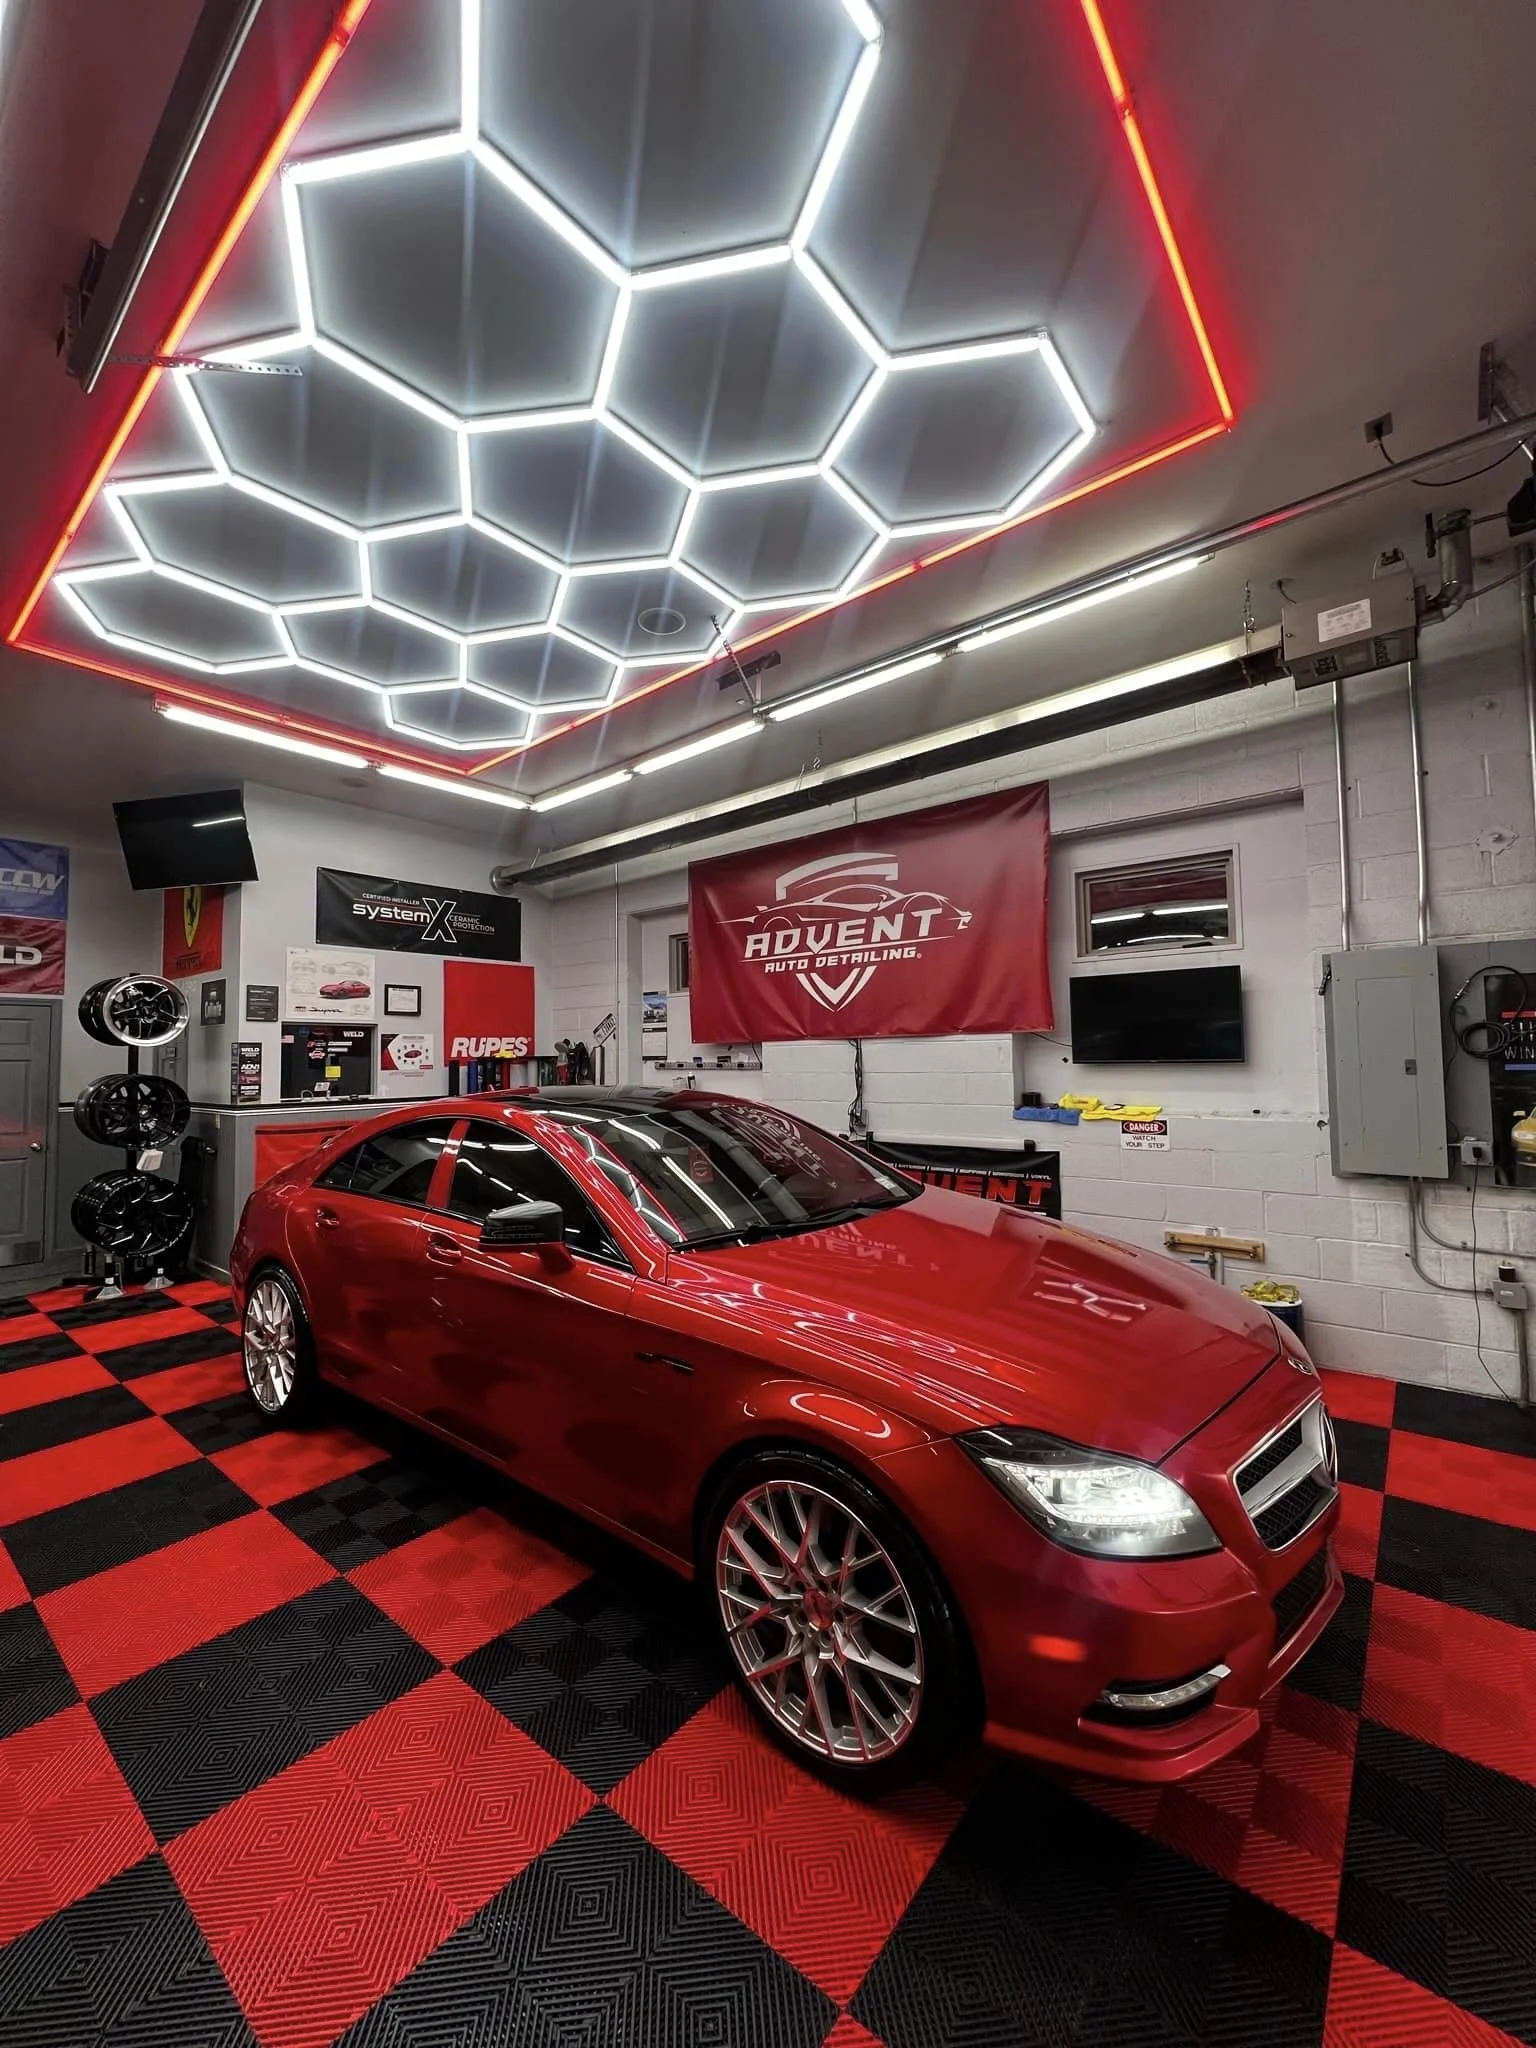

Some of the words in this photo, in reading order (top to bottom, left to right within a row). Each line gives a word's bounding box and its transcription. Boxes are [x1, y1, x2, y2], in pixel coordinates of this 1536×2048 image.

[362, 893, 391, 902] CERTIFIED
[391, 897, 420, 905] INSTALLER
[449, 915, 480, 925] CERAMIC
[452, 921, 495, 932] PROTECTION
[744, 907, 943, 958] ADVENT
[764, 958, 808, 973] AUTO
[1129, 1123, 1160, 1132] DANGER
